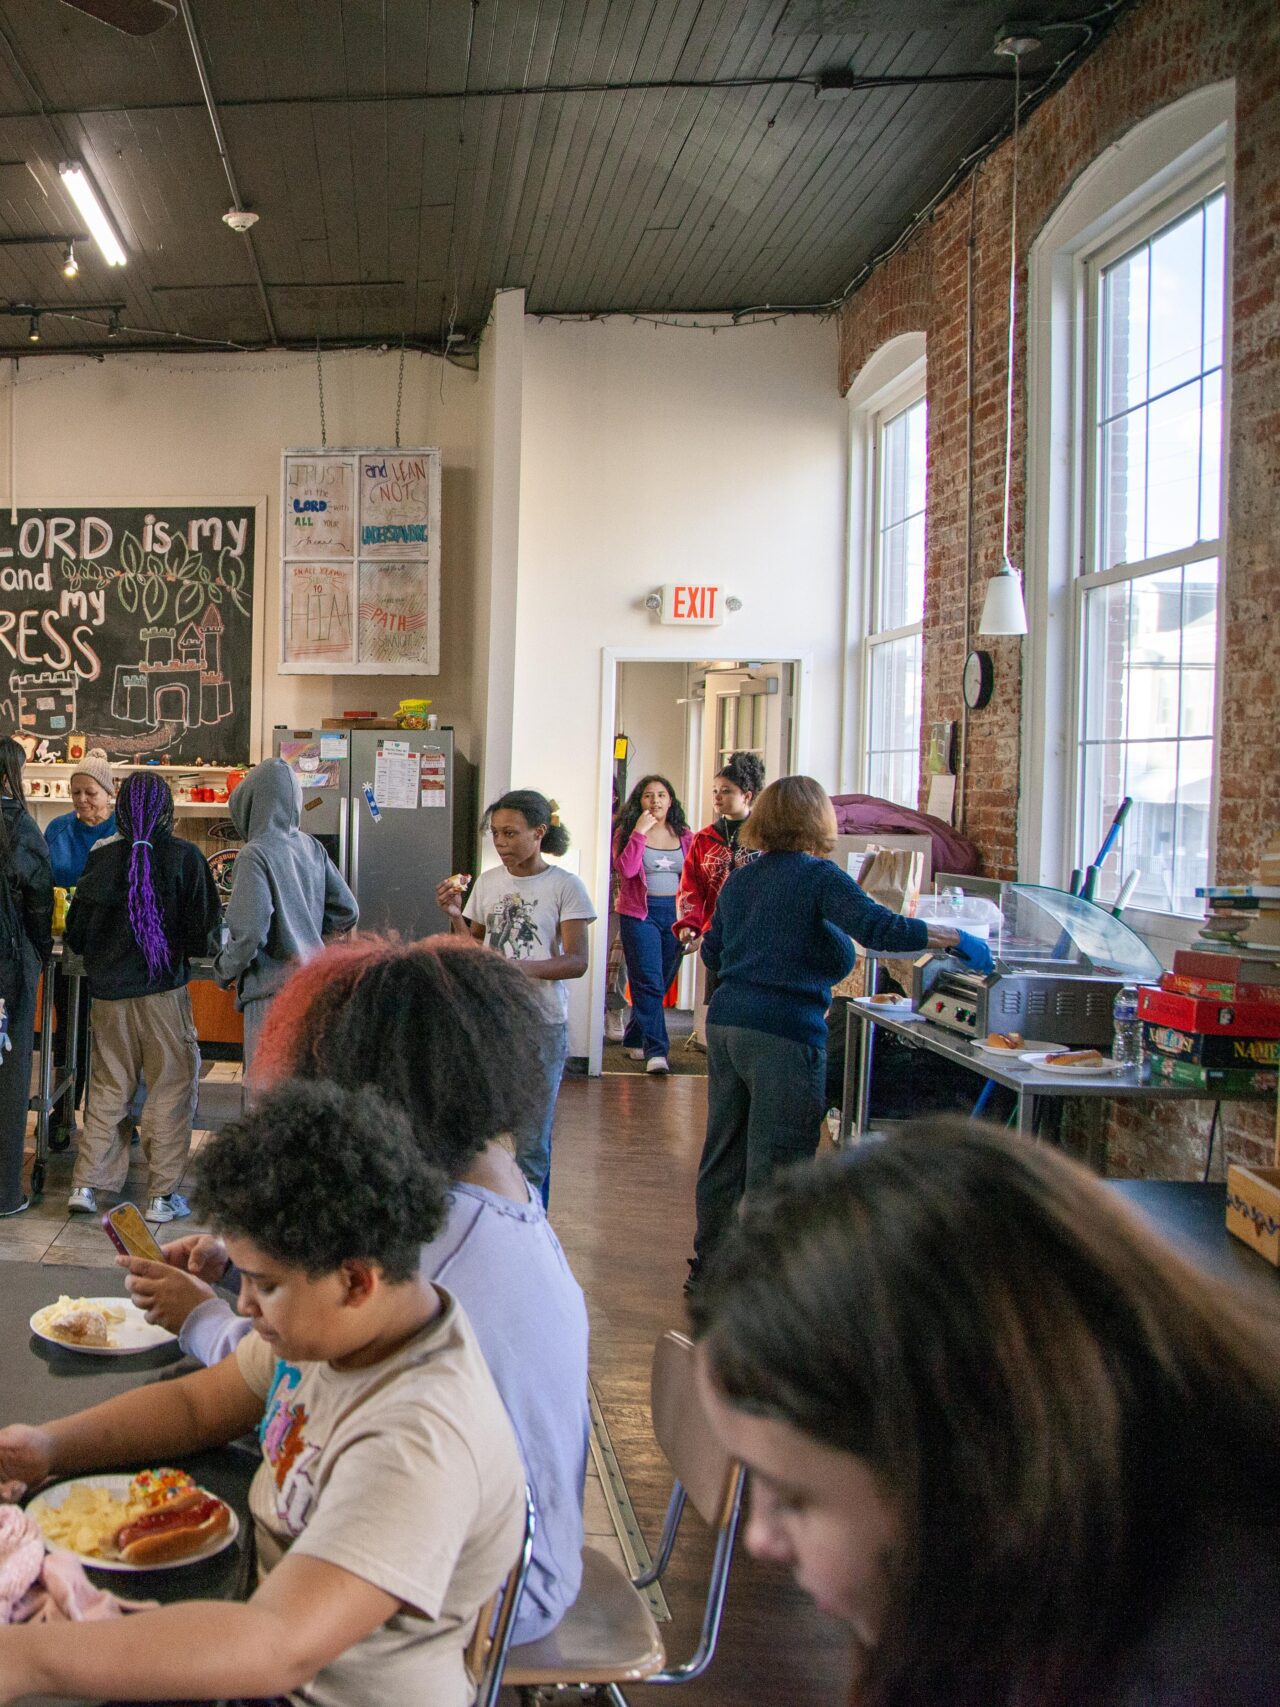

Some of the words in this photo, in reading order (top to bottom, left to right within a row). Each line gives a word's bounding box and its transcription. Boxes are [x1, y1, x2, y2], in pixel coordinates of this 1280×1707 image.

[290, 465, 350, 485] TRUST
[364, 459, 388, 478] and
[391, 459, 426, 482] LEAN
[379, 480, 415, 503] NOT
[293, 499, 327, 513] LORD
[294, 517, 314, 526] ALL
[143, 514, 172, 553] is
[188, 515, 248, 557] my
[0, 563, 53, 592] and
[60, 589, 105, 625] my
[673, 586, 718, 618] EXIT
[370, 607, 406, 631] PATH
